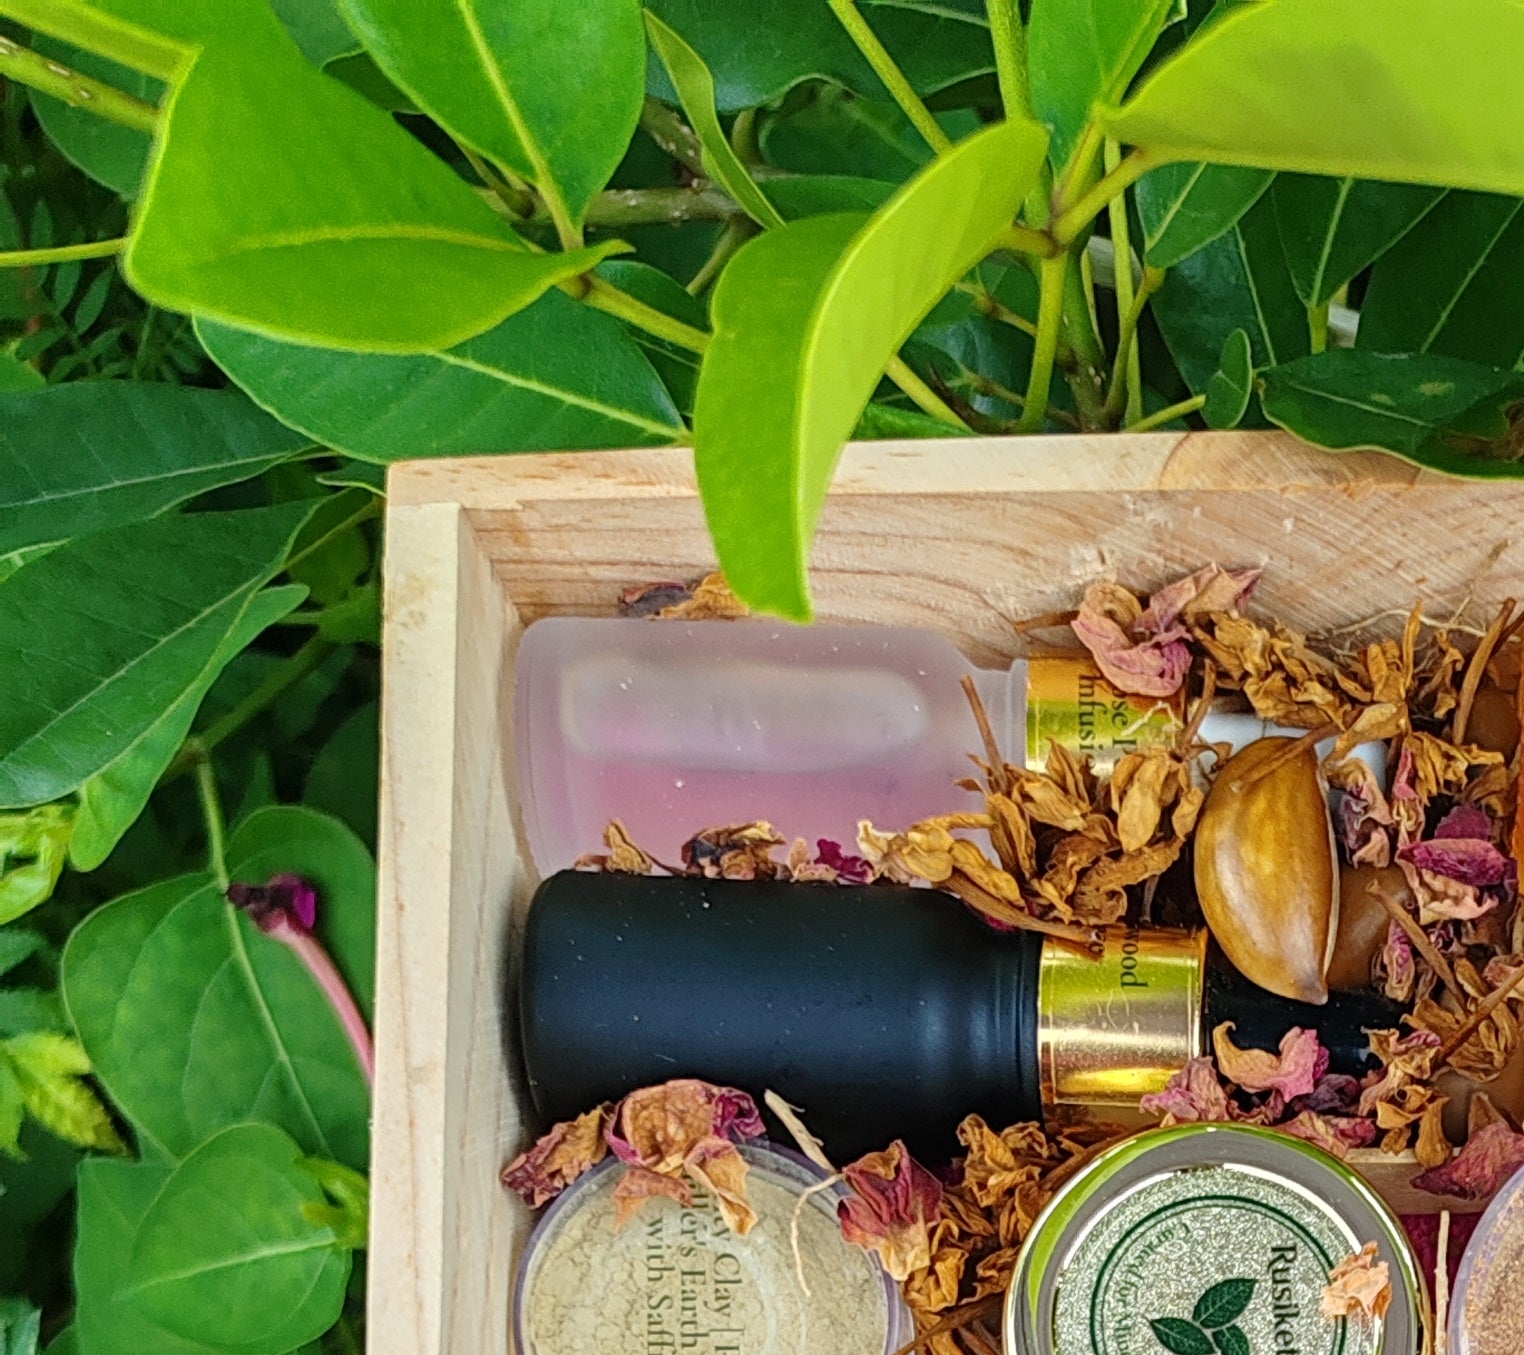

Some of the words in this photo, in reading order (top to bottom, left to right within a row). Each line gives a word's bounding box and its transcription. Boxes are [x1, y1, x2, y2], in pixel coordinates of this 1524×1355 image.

[1077, 674, 1108, 769] Infusi
[646, 1217, 678, 1283] with
[704, 1252, 742, 1318] Clay
[679, 1269, 707, 1348] Earth
